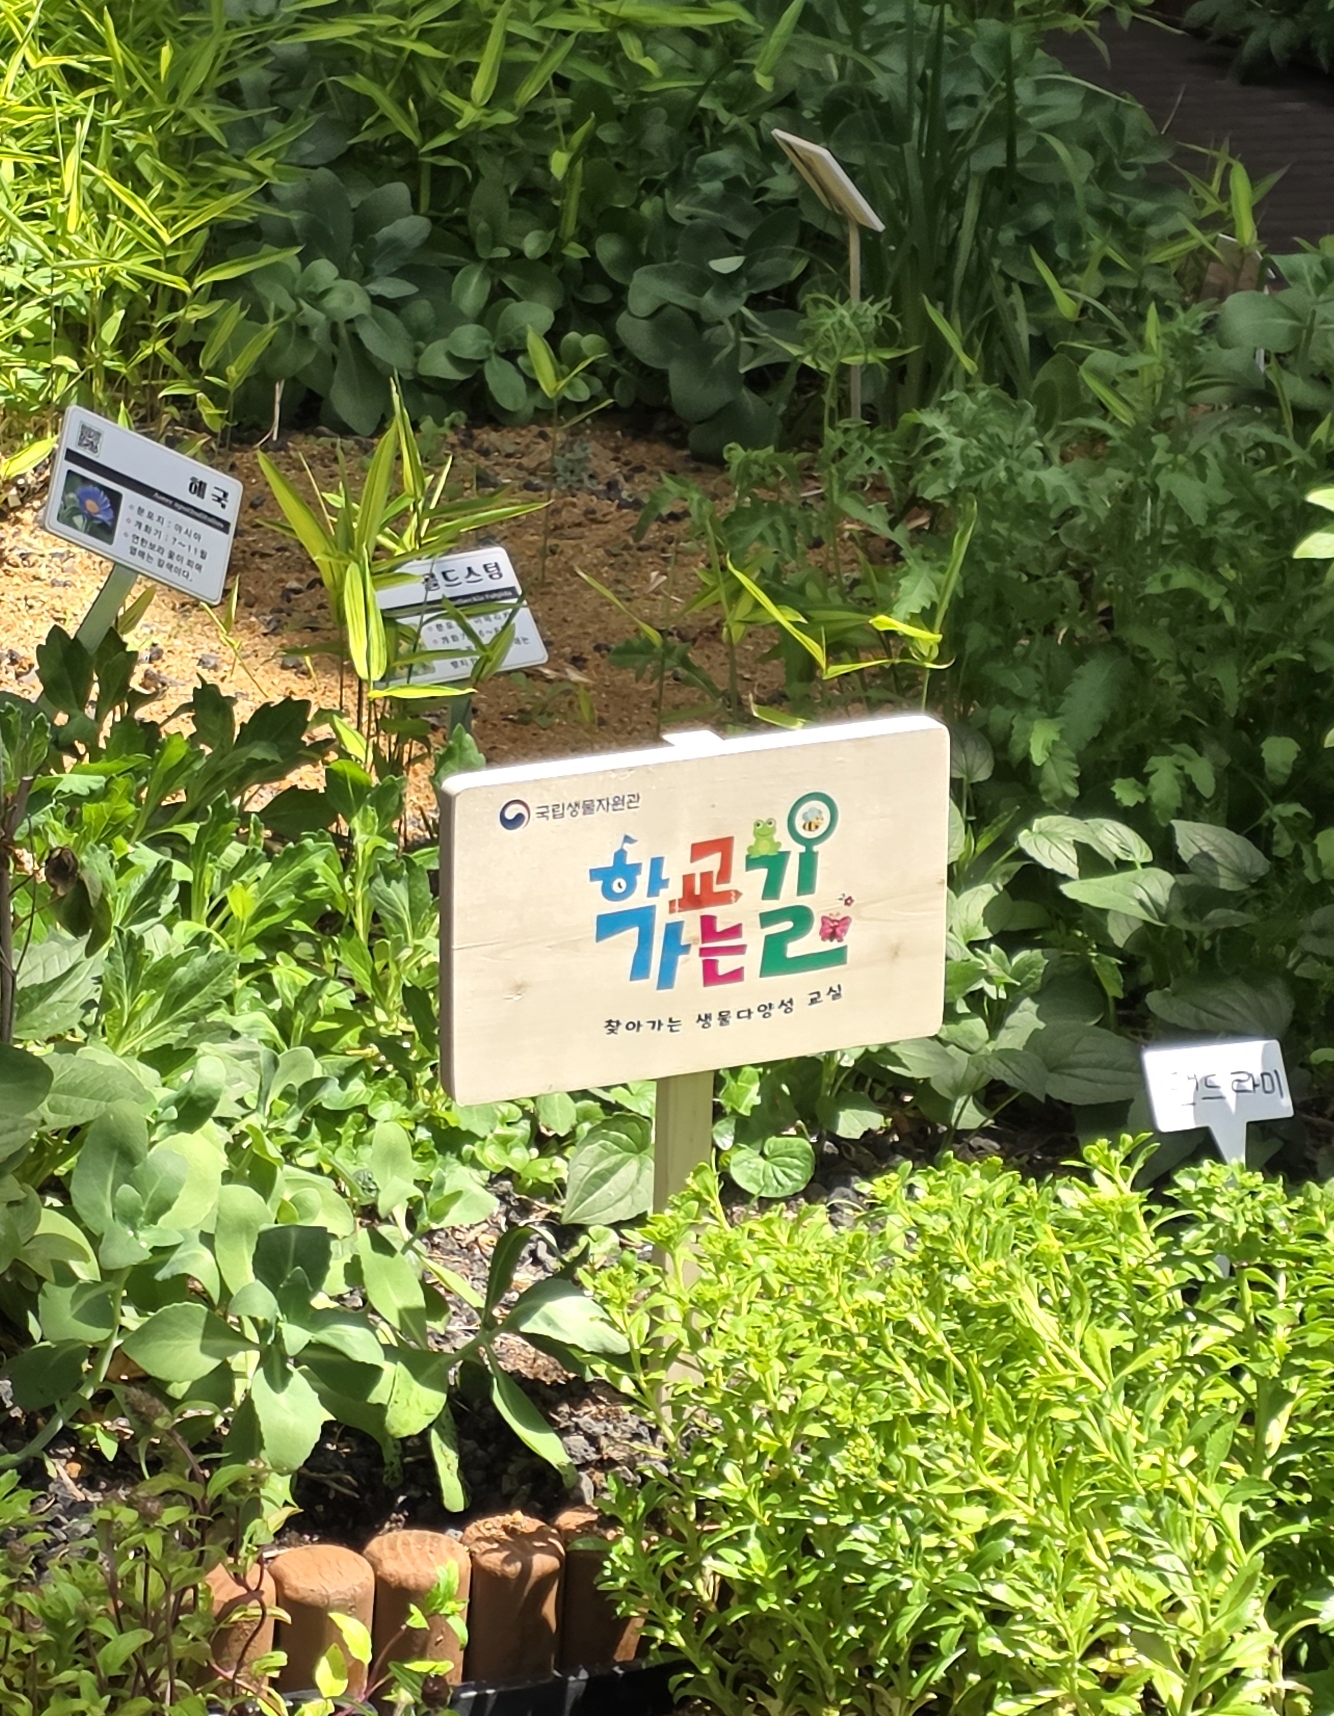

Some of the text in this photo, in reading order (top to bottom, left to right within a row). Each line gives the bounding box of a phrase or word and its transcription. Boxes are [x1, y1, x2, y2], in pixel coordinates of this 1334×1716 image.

[188, 476, 229, 510] 해국
[133, 520, 162, 540] 개화기
[173, 523, 202, 543] 아시아
[129, 545, 155, 565] 열매는
[535, 792, 641, 821] 국립생물자원관
[603, 984, 844, 1036] 찾아가는 생물다양성 교실
